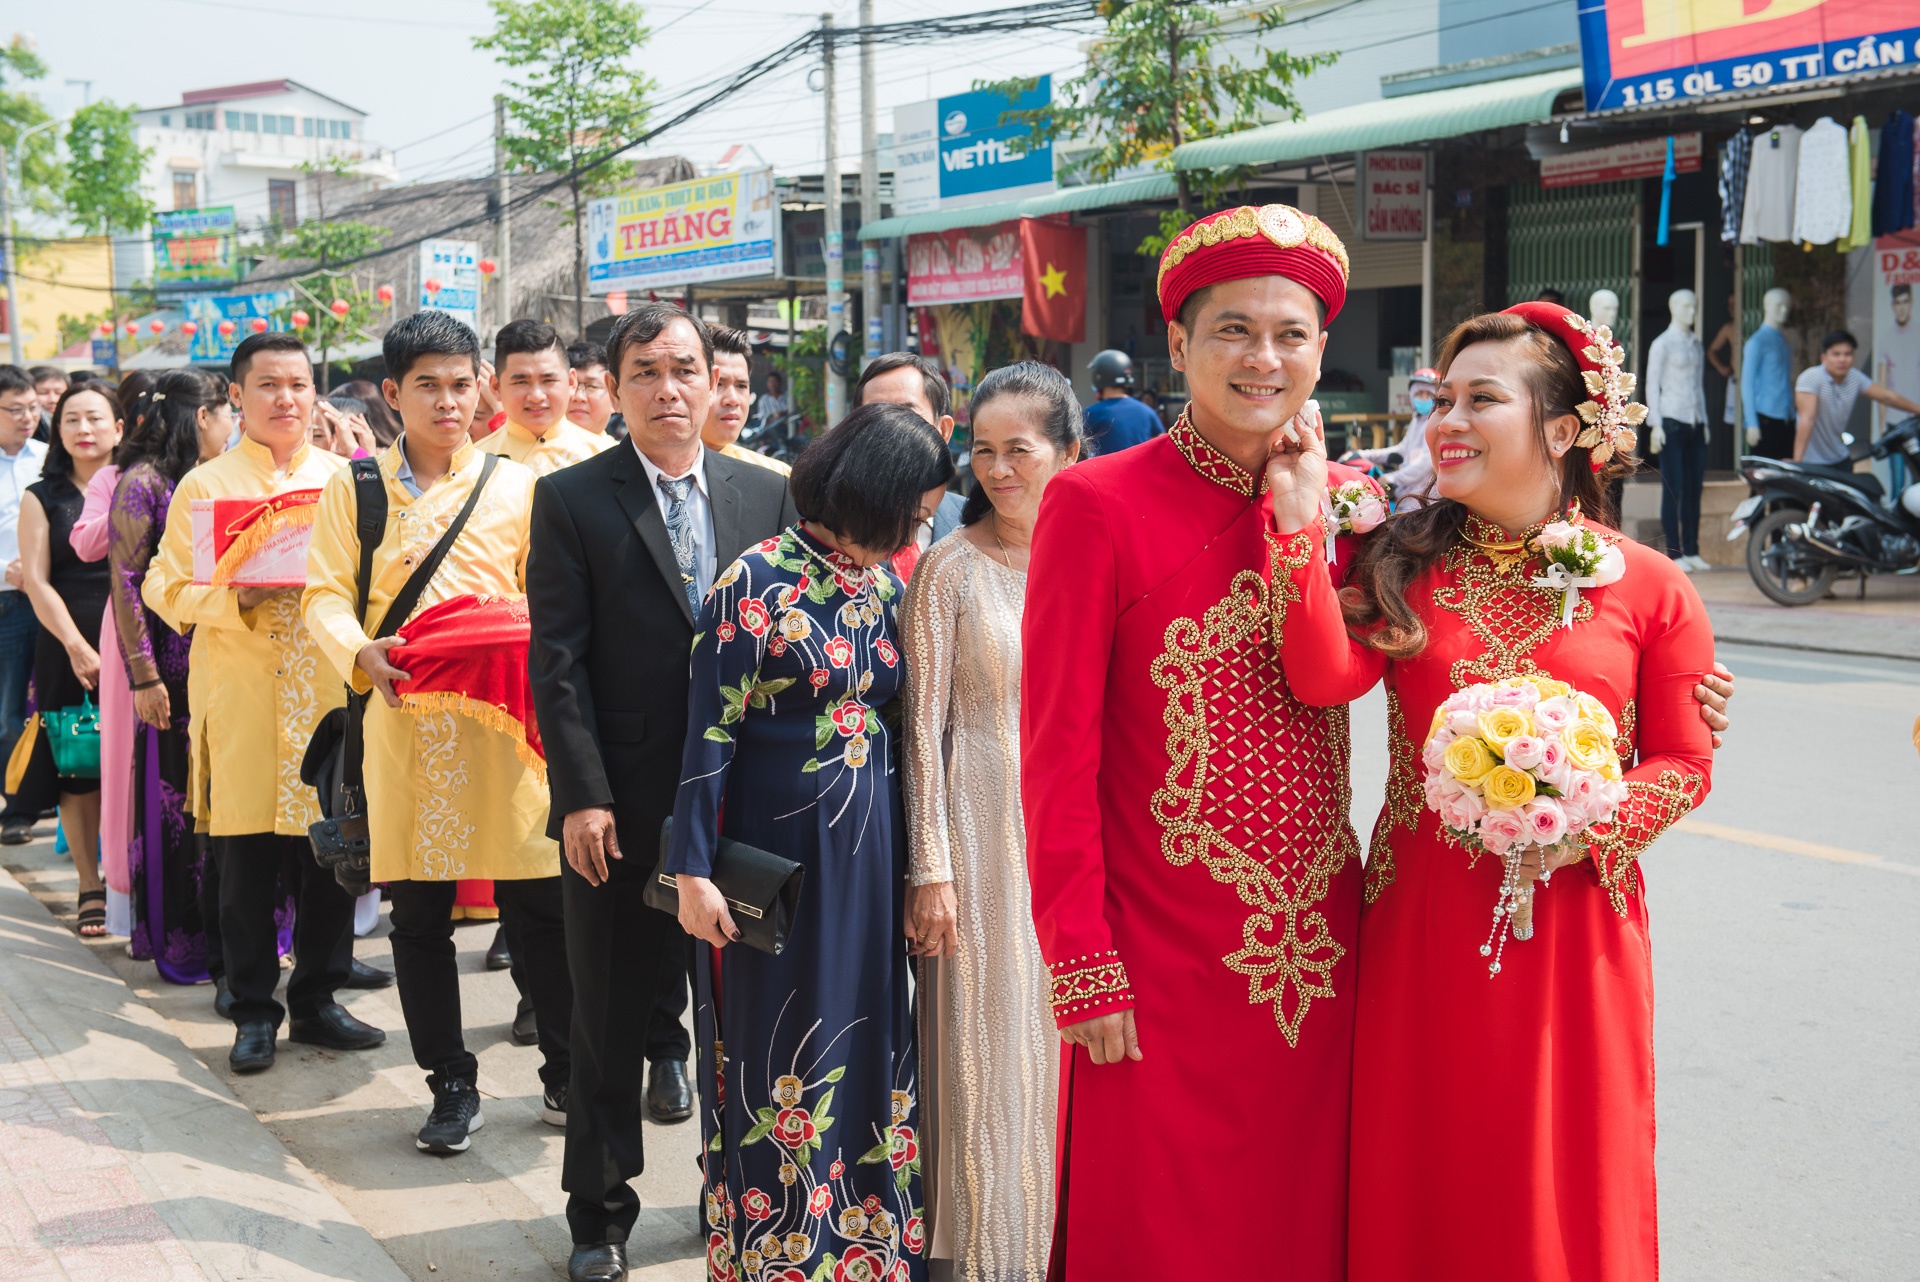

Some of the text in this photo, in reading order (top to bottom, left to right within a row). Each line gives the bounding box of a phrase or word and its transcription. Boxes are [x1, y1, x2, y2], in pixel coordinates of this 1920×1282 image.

[1621, 79, 1675, 107] 115
[1683, 71, 1723, 97] QL
[1732, 61, 1773, 88] 50
[1780, 53, 1824, 79] TT
[1373, 179, 1402, 195] BÁC
